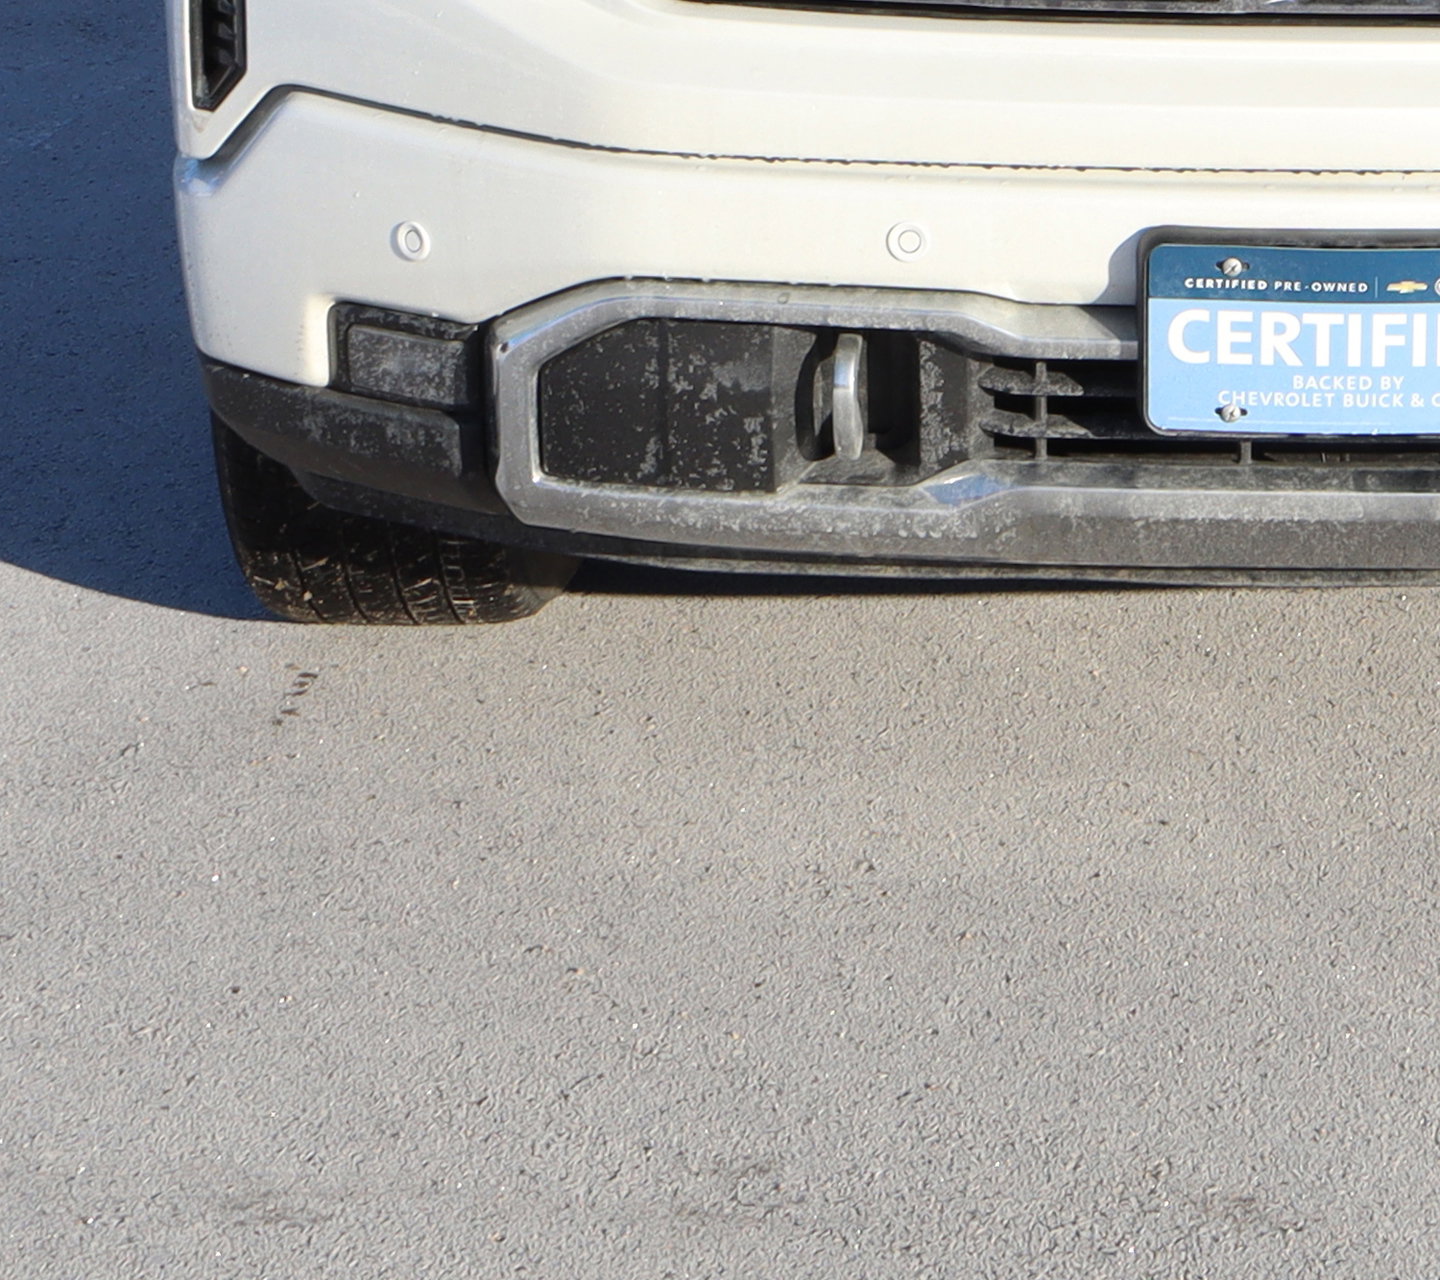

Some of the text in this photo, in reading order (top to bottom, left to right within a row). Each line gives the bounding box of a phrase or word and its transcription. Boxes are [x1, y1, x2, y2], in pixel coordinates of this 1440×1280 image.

[1184, 277, 1268, 290] CERTIFIED
[1292, 375, 1405, 391] BACKED BY
[1217, 391, 1335, 409] CHEVROLET
[1343, 393, 1403, 409] BUICK
[1411, 393, 1425, 408] &
